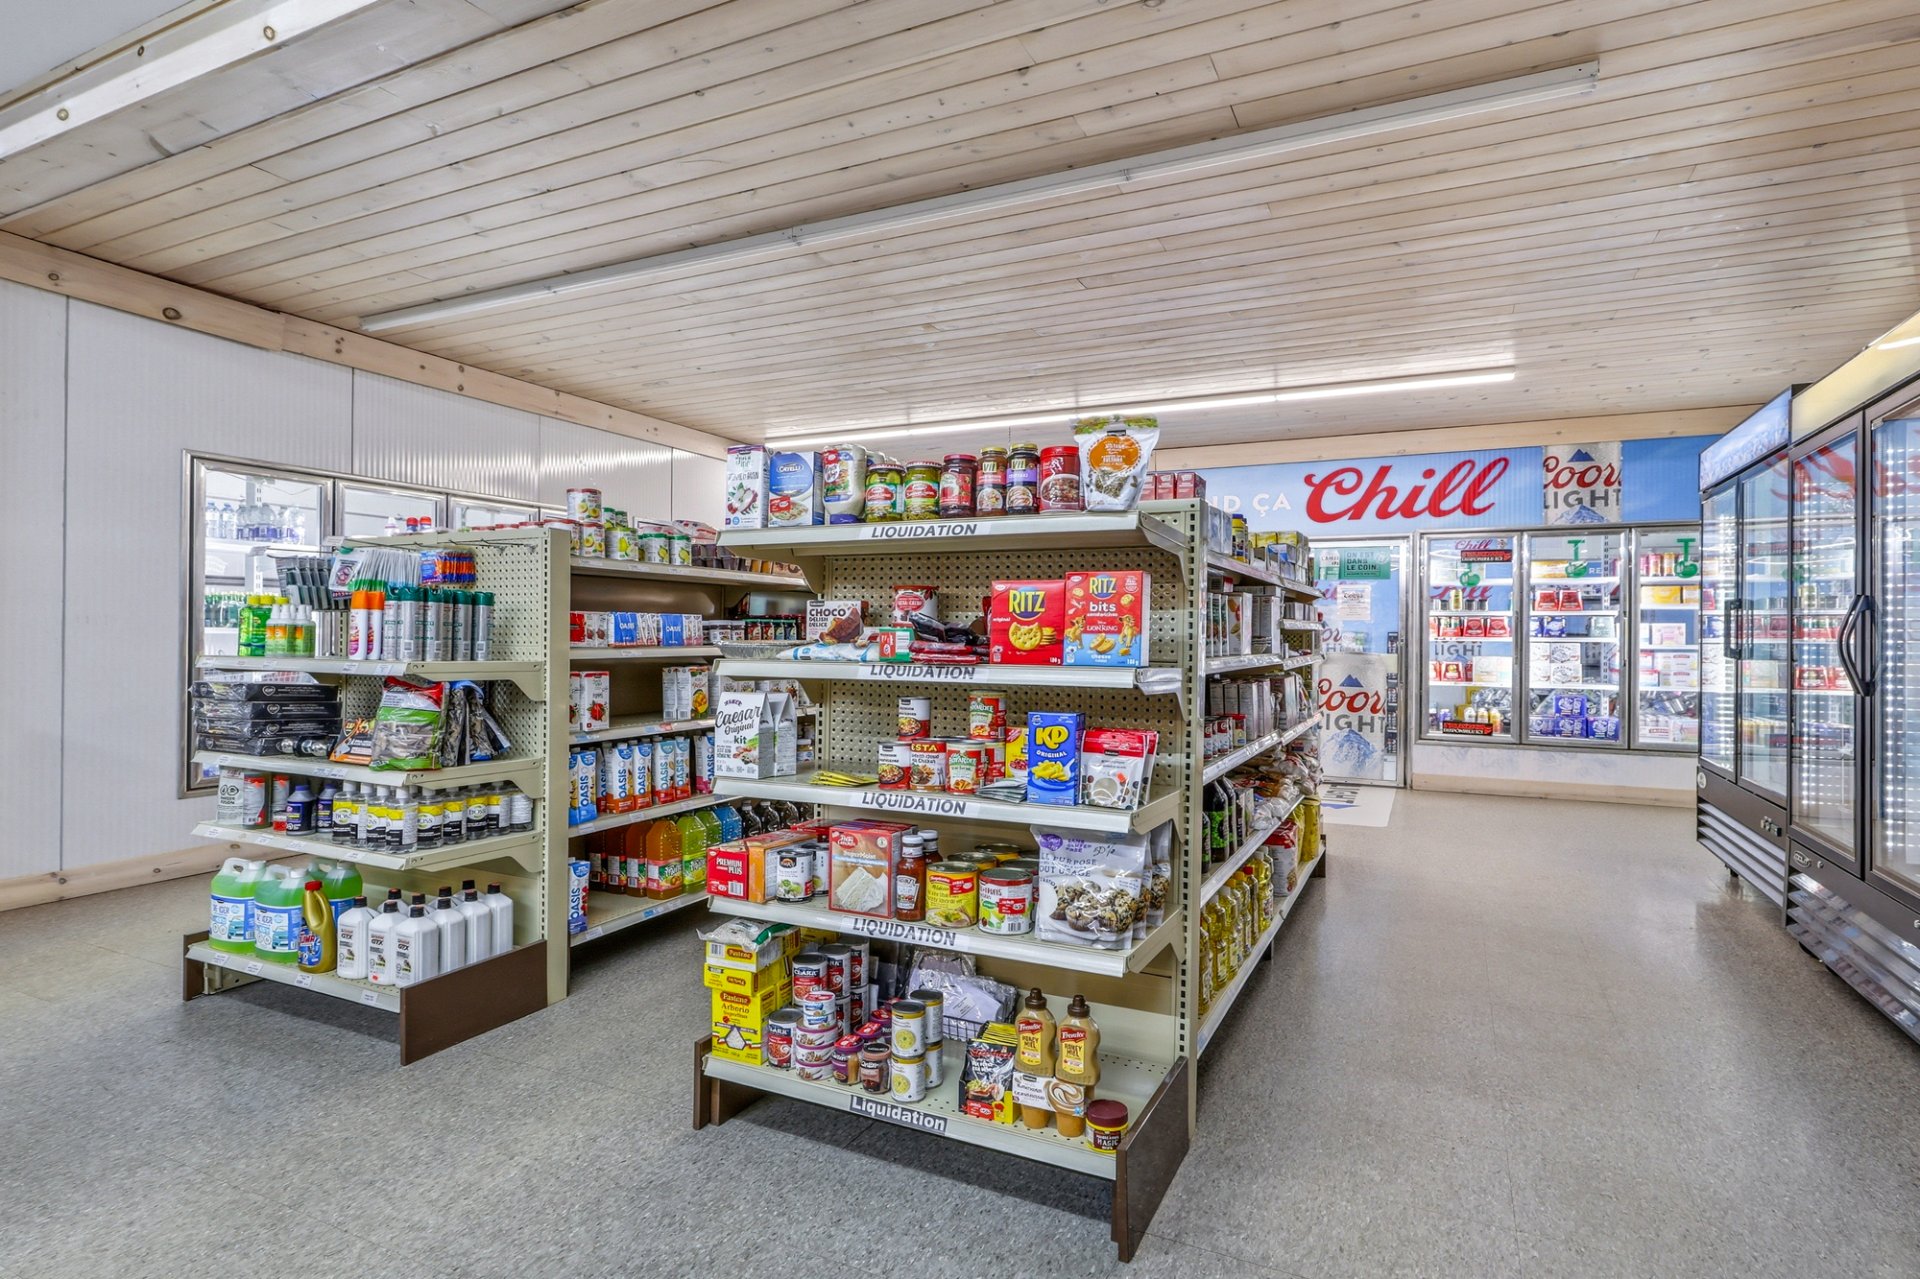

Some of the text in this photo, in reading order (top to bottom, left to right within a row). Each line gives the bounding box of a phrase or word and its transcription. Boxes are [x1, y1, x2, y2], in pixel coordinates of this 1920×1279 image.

[1543, 456, 1622, 489] Coor
[1252, 493, 1291, 517] ÇA
[1304, 457, 1510, 524] Chill
[871, 524, 978, 538] LIQUIDATION
[1089, 577, 1117, 594] RITZ
[809, 608, 847, 617] CHOCO
[1009, 589, 1046, 613] RITZ
[1089, 602, 1117, 611] bits
[871, 664, 976, 680] LIQUIDATION
[1318, 678, 1387, 714] Coor
[715, 706, 761, 728] Caesar
[1317, 713, 1385, 733] IGHT
[734, 735, 747, 745] kit
[1035, 726, 1069, 750] KD
[1036, 750, 1068, 759] ORIGINAL
[660, 761, 669, 790] OASIS
[677, 758, 685, 787] OASIS
[707, 754, 715, 781] ASIS
[579, 775, 589, 807] OASIS
[618, 768, 627, 799] OASIS
[638, 765, 646, 795] OASIS
[862, 792, 967, 815] LIQUIDATION
[716, 857, 743, 867] PREMIUM
[728, 866, 743, 875] PLUS
[1053, 856, 1097, 865] PURPOSE
[571, 887, 580, 919] OASIS
[852, 919, 957, 946] LIQUIDATION
[398, 943, 410, 951] GTX
[721, 1003, 749, 1014] Arborio
[851, 1096, 946, 1132] Liquidation
